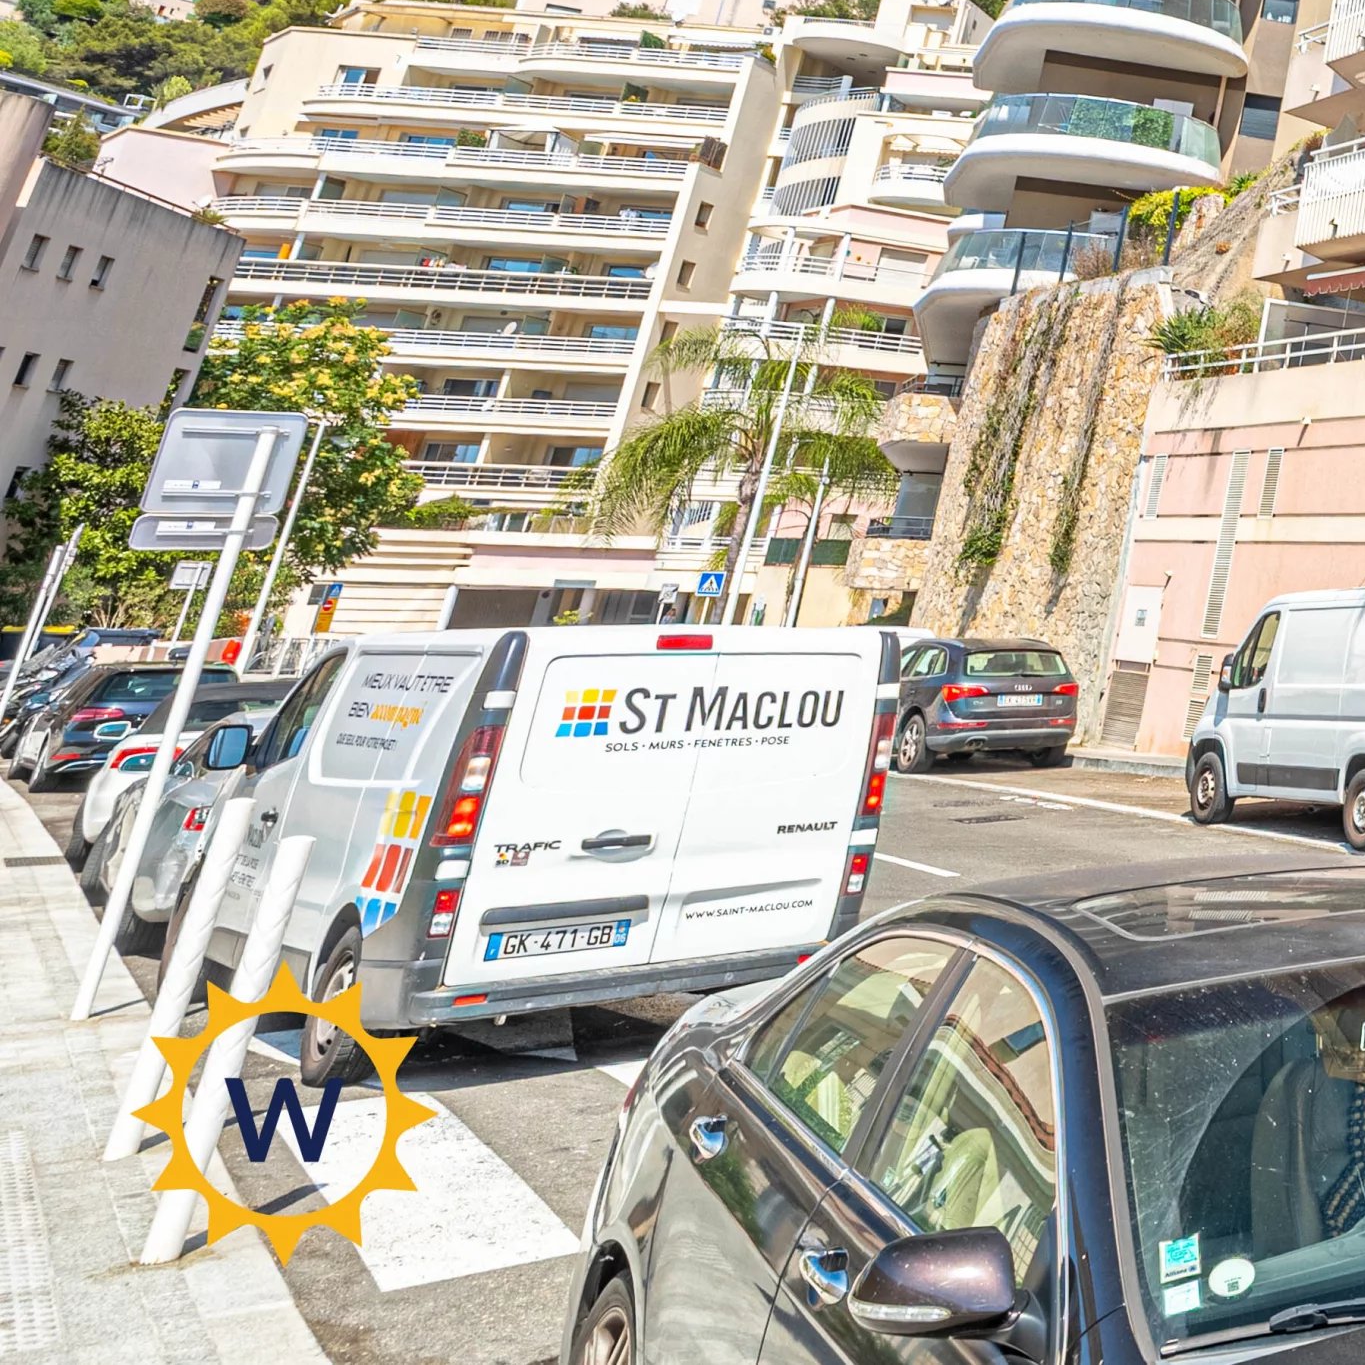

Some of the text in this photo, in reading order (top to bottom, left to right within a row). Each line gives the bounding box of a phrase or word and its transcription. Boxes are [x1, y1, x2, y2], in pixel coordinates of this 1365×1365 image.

[684, 686, 845, 732] MACLOU
[605, 742, 639, 753] SOLS
[648, 740, 684, 750] MURS
[760, 736, 790, 746] POSE
[777, 821, 838, 834] RENAULT
[494, 840, 562, 853] TRAFIC
[685, 899, 813, 920] WWW.SAINT-MACLOU.COM
[503, 925, 613, 955] GK-471-GB
